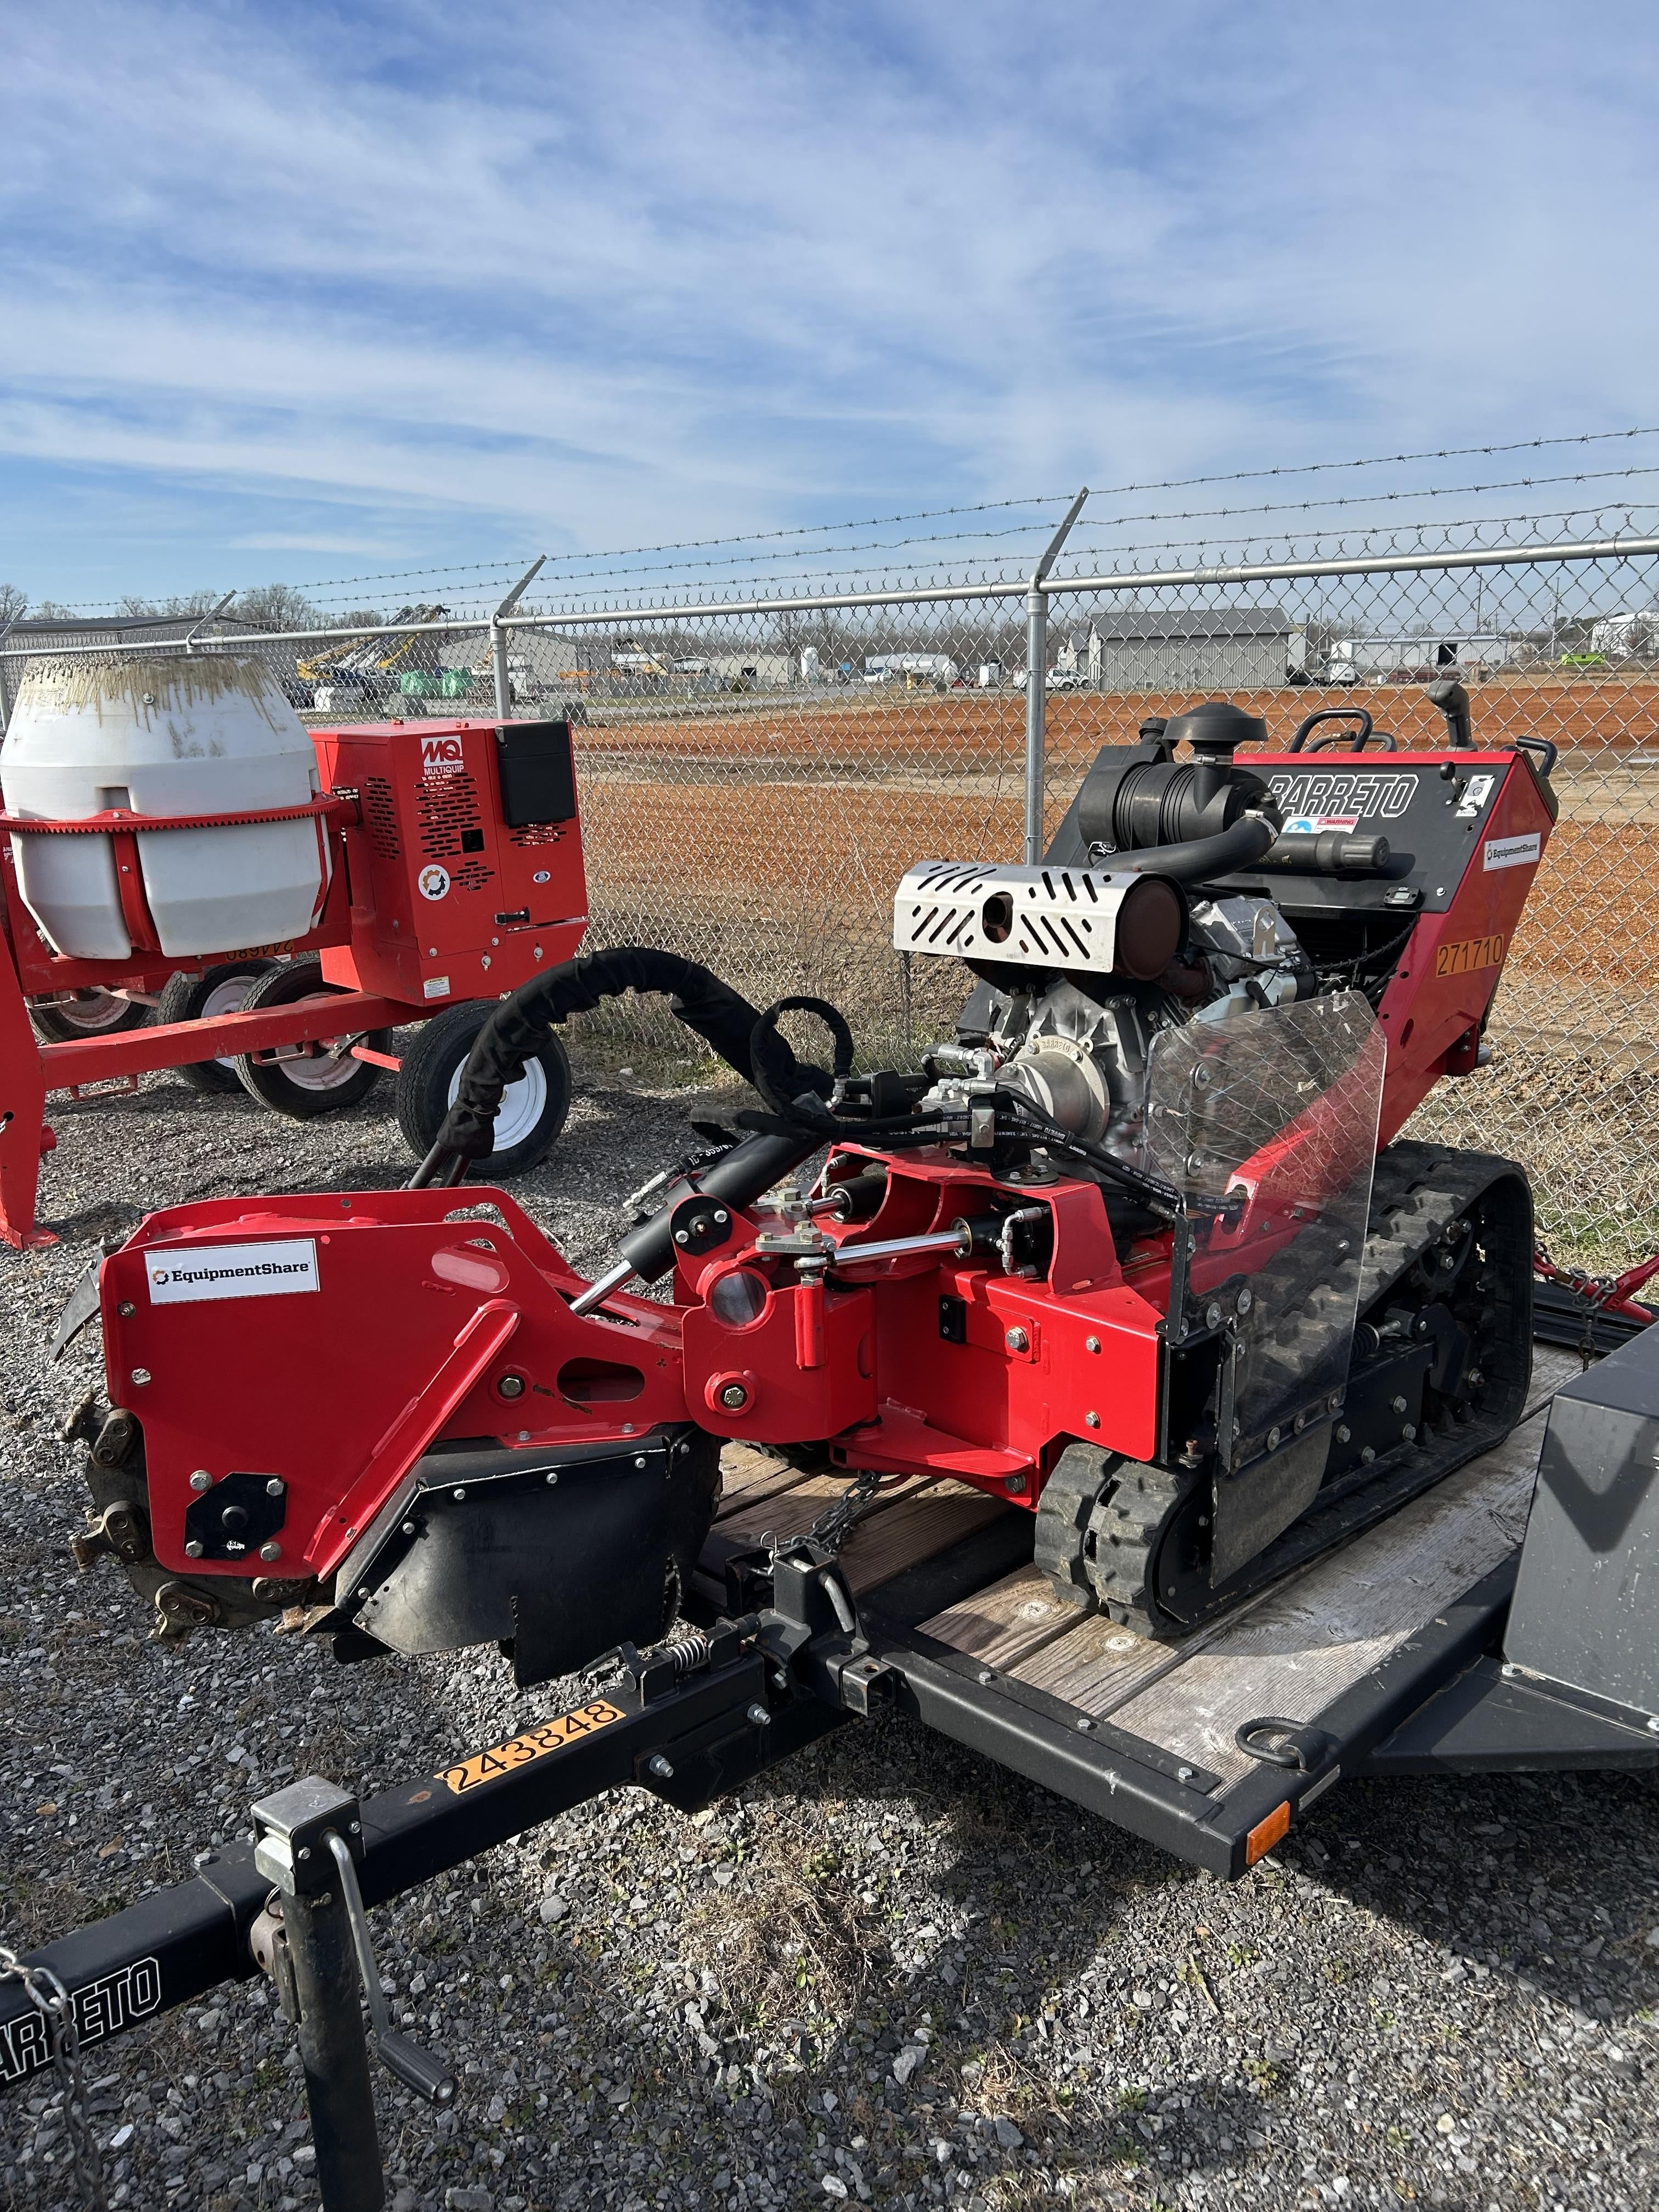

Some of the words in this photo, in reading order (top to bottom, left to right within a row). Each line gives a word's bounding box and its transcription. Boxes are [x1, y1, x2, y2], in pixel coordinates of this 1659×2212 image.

[422, 740, 462, 762] MQ
[424, 765, 464, 776] MULTIQUIP
[1268, 775, 1419, 817] BARRETO
[1493, 844, 1537, 859] EquipmentShare
[1437, 935, 1503, 975] 271710
[172, 1263, 309, 1283] EquipmentShare
[443, 1704, 618, 1791] 243848
